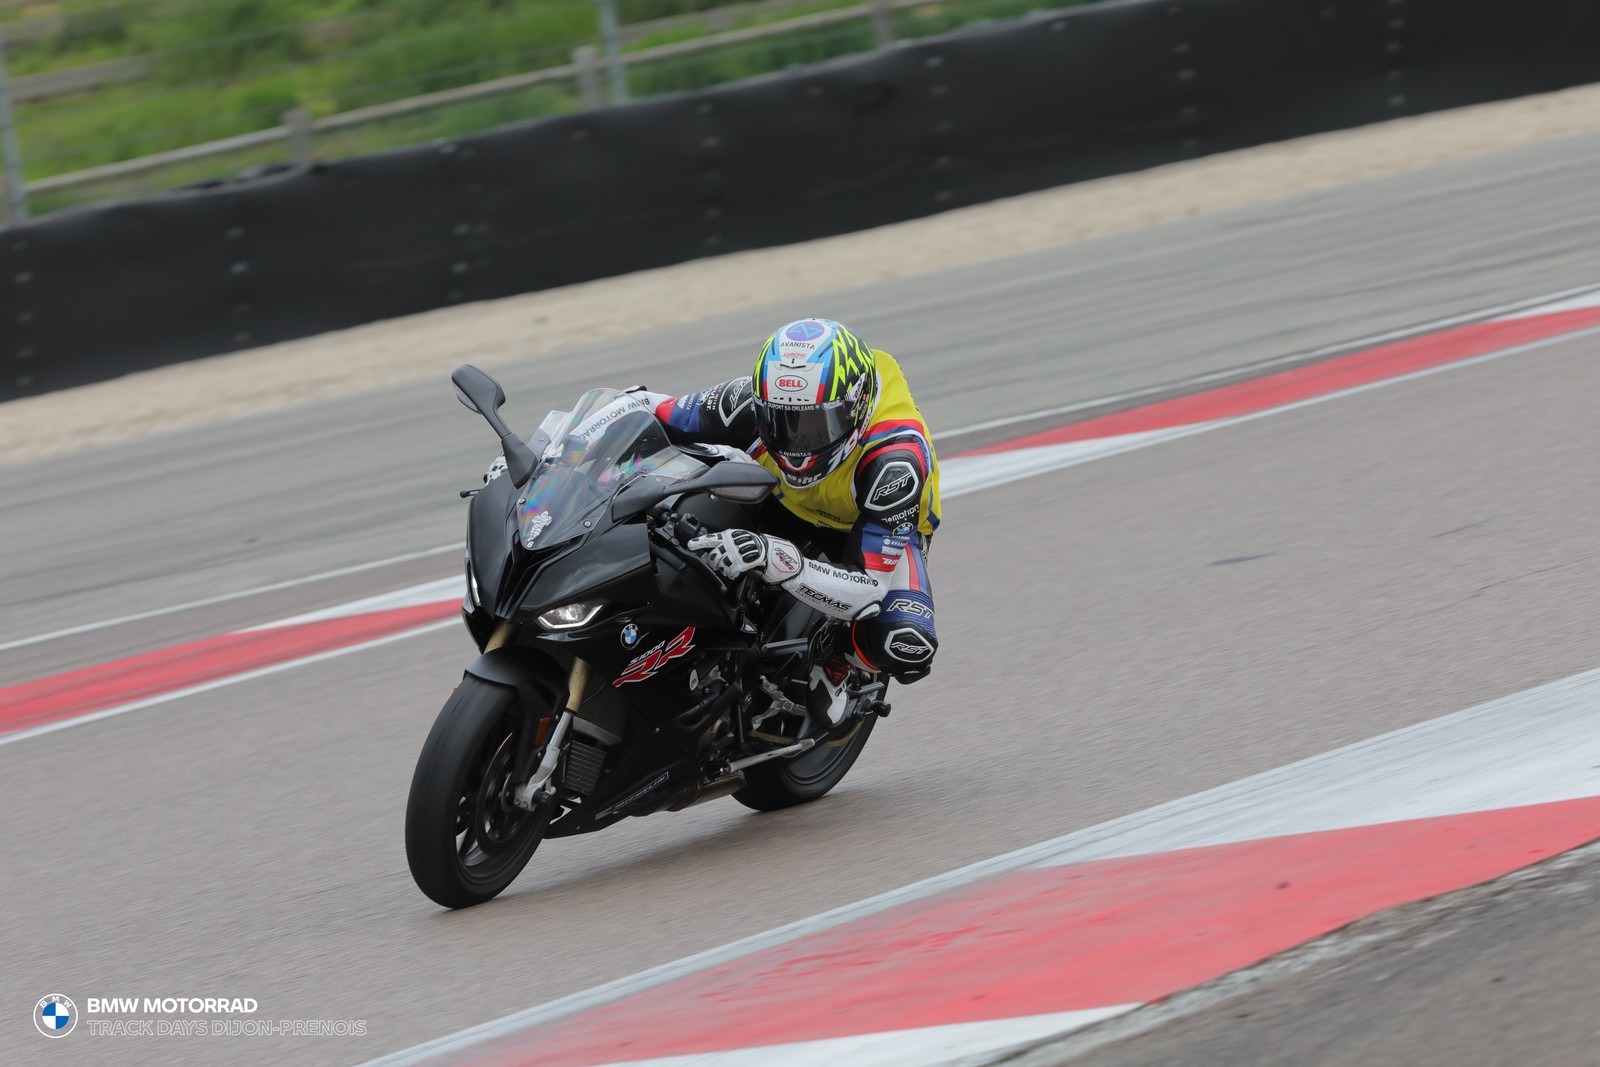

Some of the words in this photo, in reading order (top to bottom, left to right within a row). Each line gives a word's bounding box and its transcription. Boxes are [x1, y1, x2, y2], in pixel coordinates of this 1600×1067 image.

[780, 341, 815, 350] AVANISTA
[779, 379, 803, 388] BELL
[872, 472, 912, 501] RST
[808, 561, 831, 575] BMW
[799, 584, 853, 611] TECMAS
[886, 598, 934, 620] RST
[628, 640, 666, 666] S1000
[890, 641, 929, 655] RST
